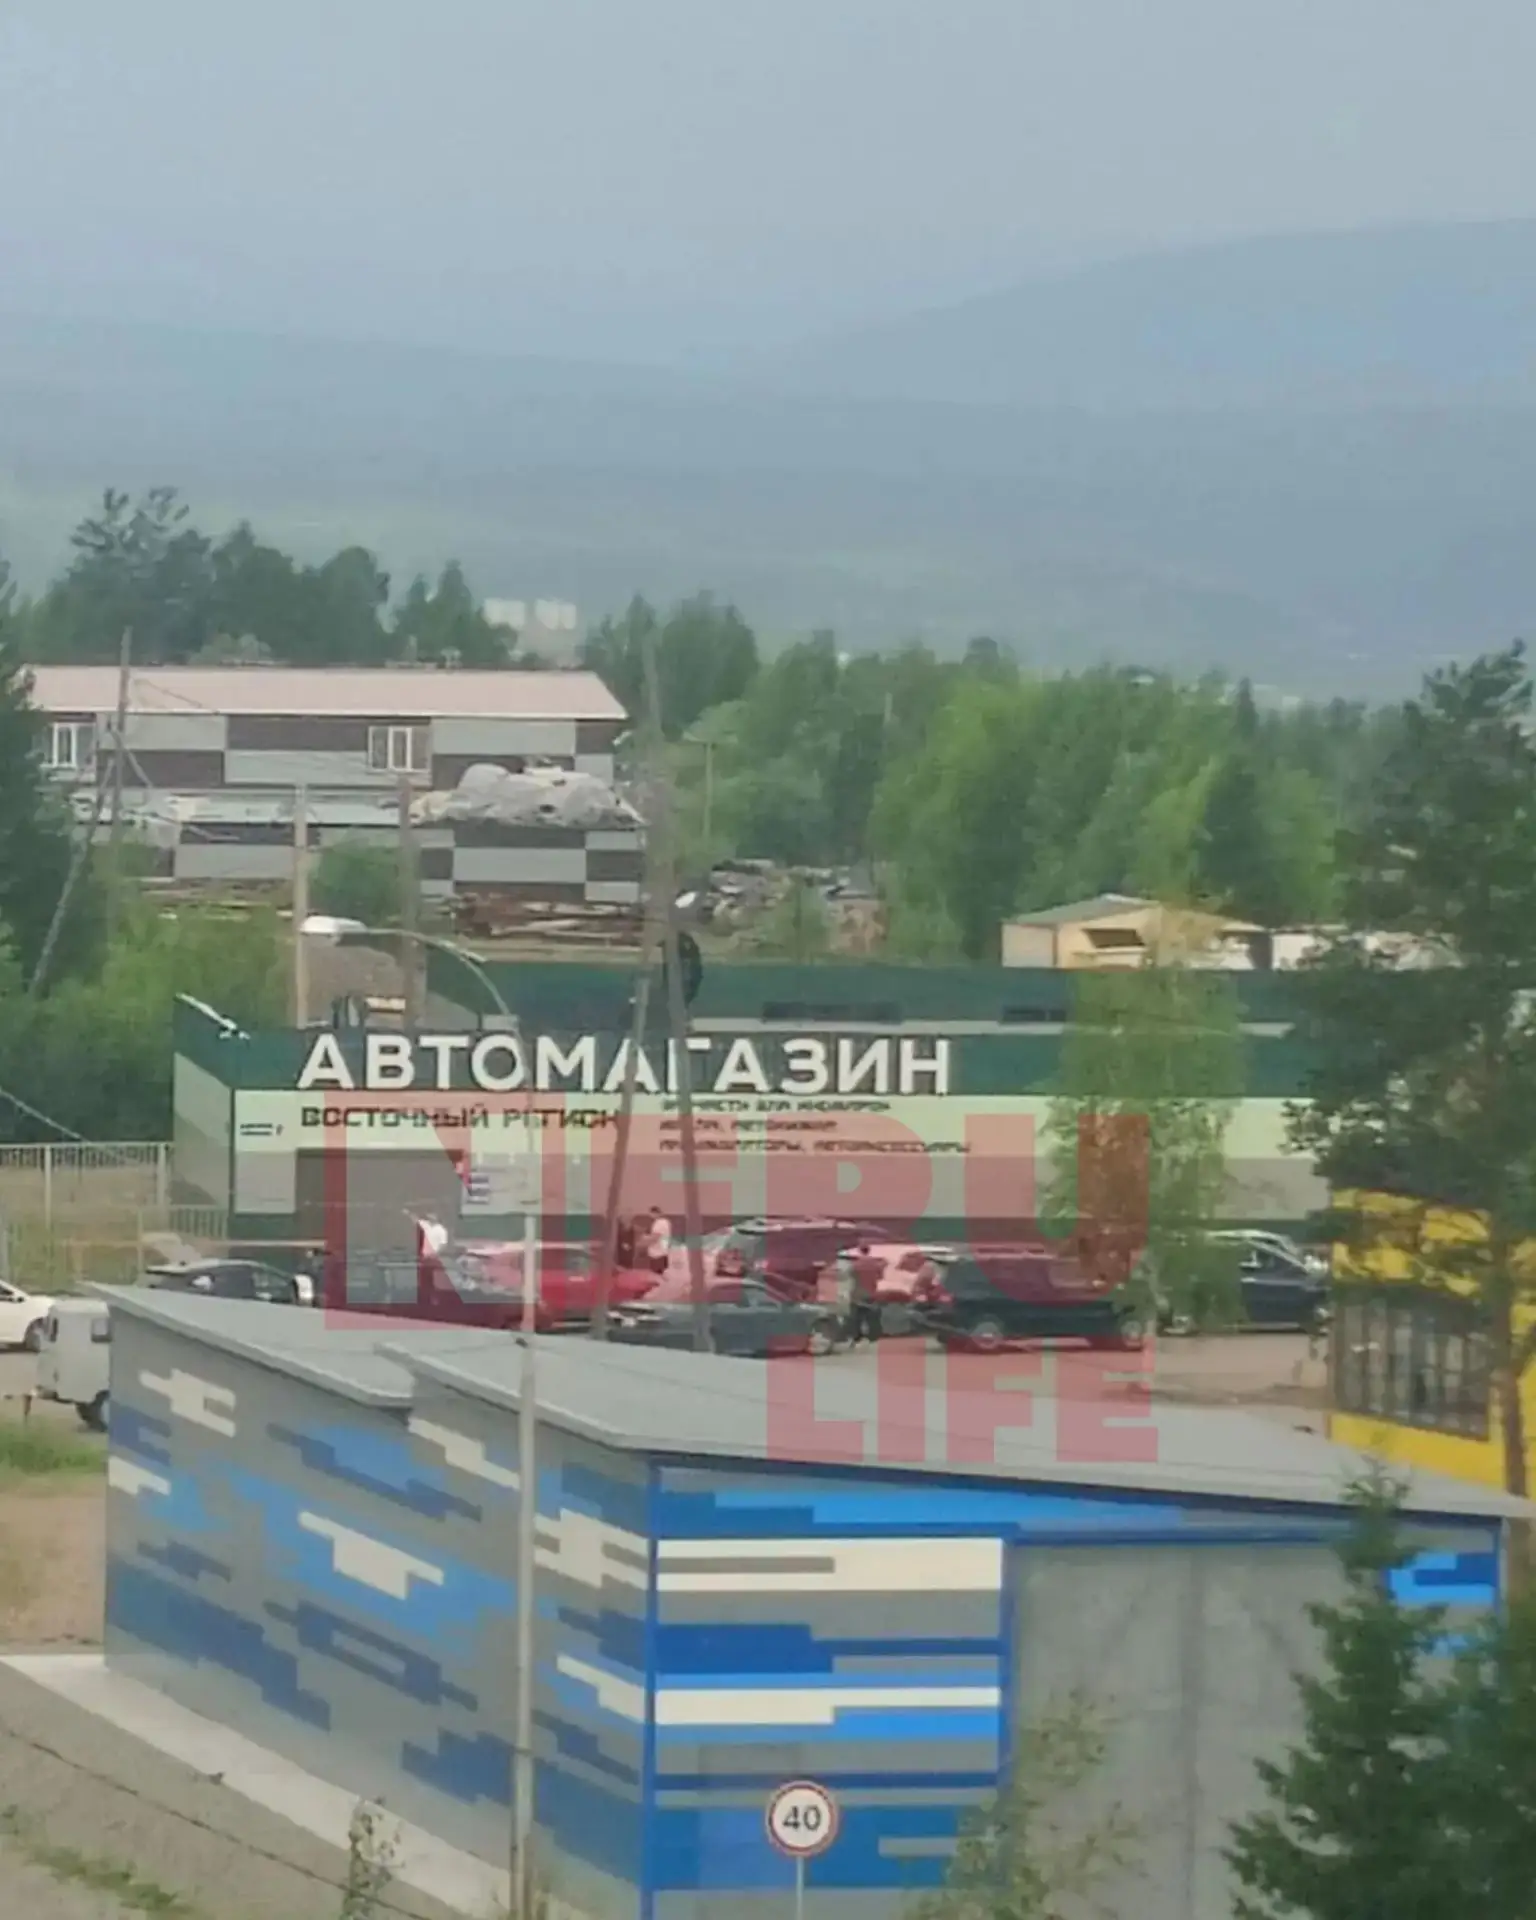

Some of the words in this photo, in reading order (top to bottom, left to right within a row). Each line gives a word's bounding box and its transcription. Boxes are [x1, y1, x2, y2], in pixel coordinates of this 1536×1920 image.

[297, 1034, 950, 1094] АВТОМАГАЗИН
[301, 1104, 489, 1128] ВОСТОЧНЫЙ
[783, 1805, 821, 1831] 40
